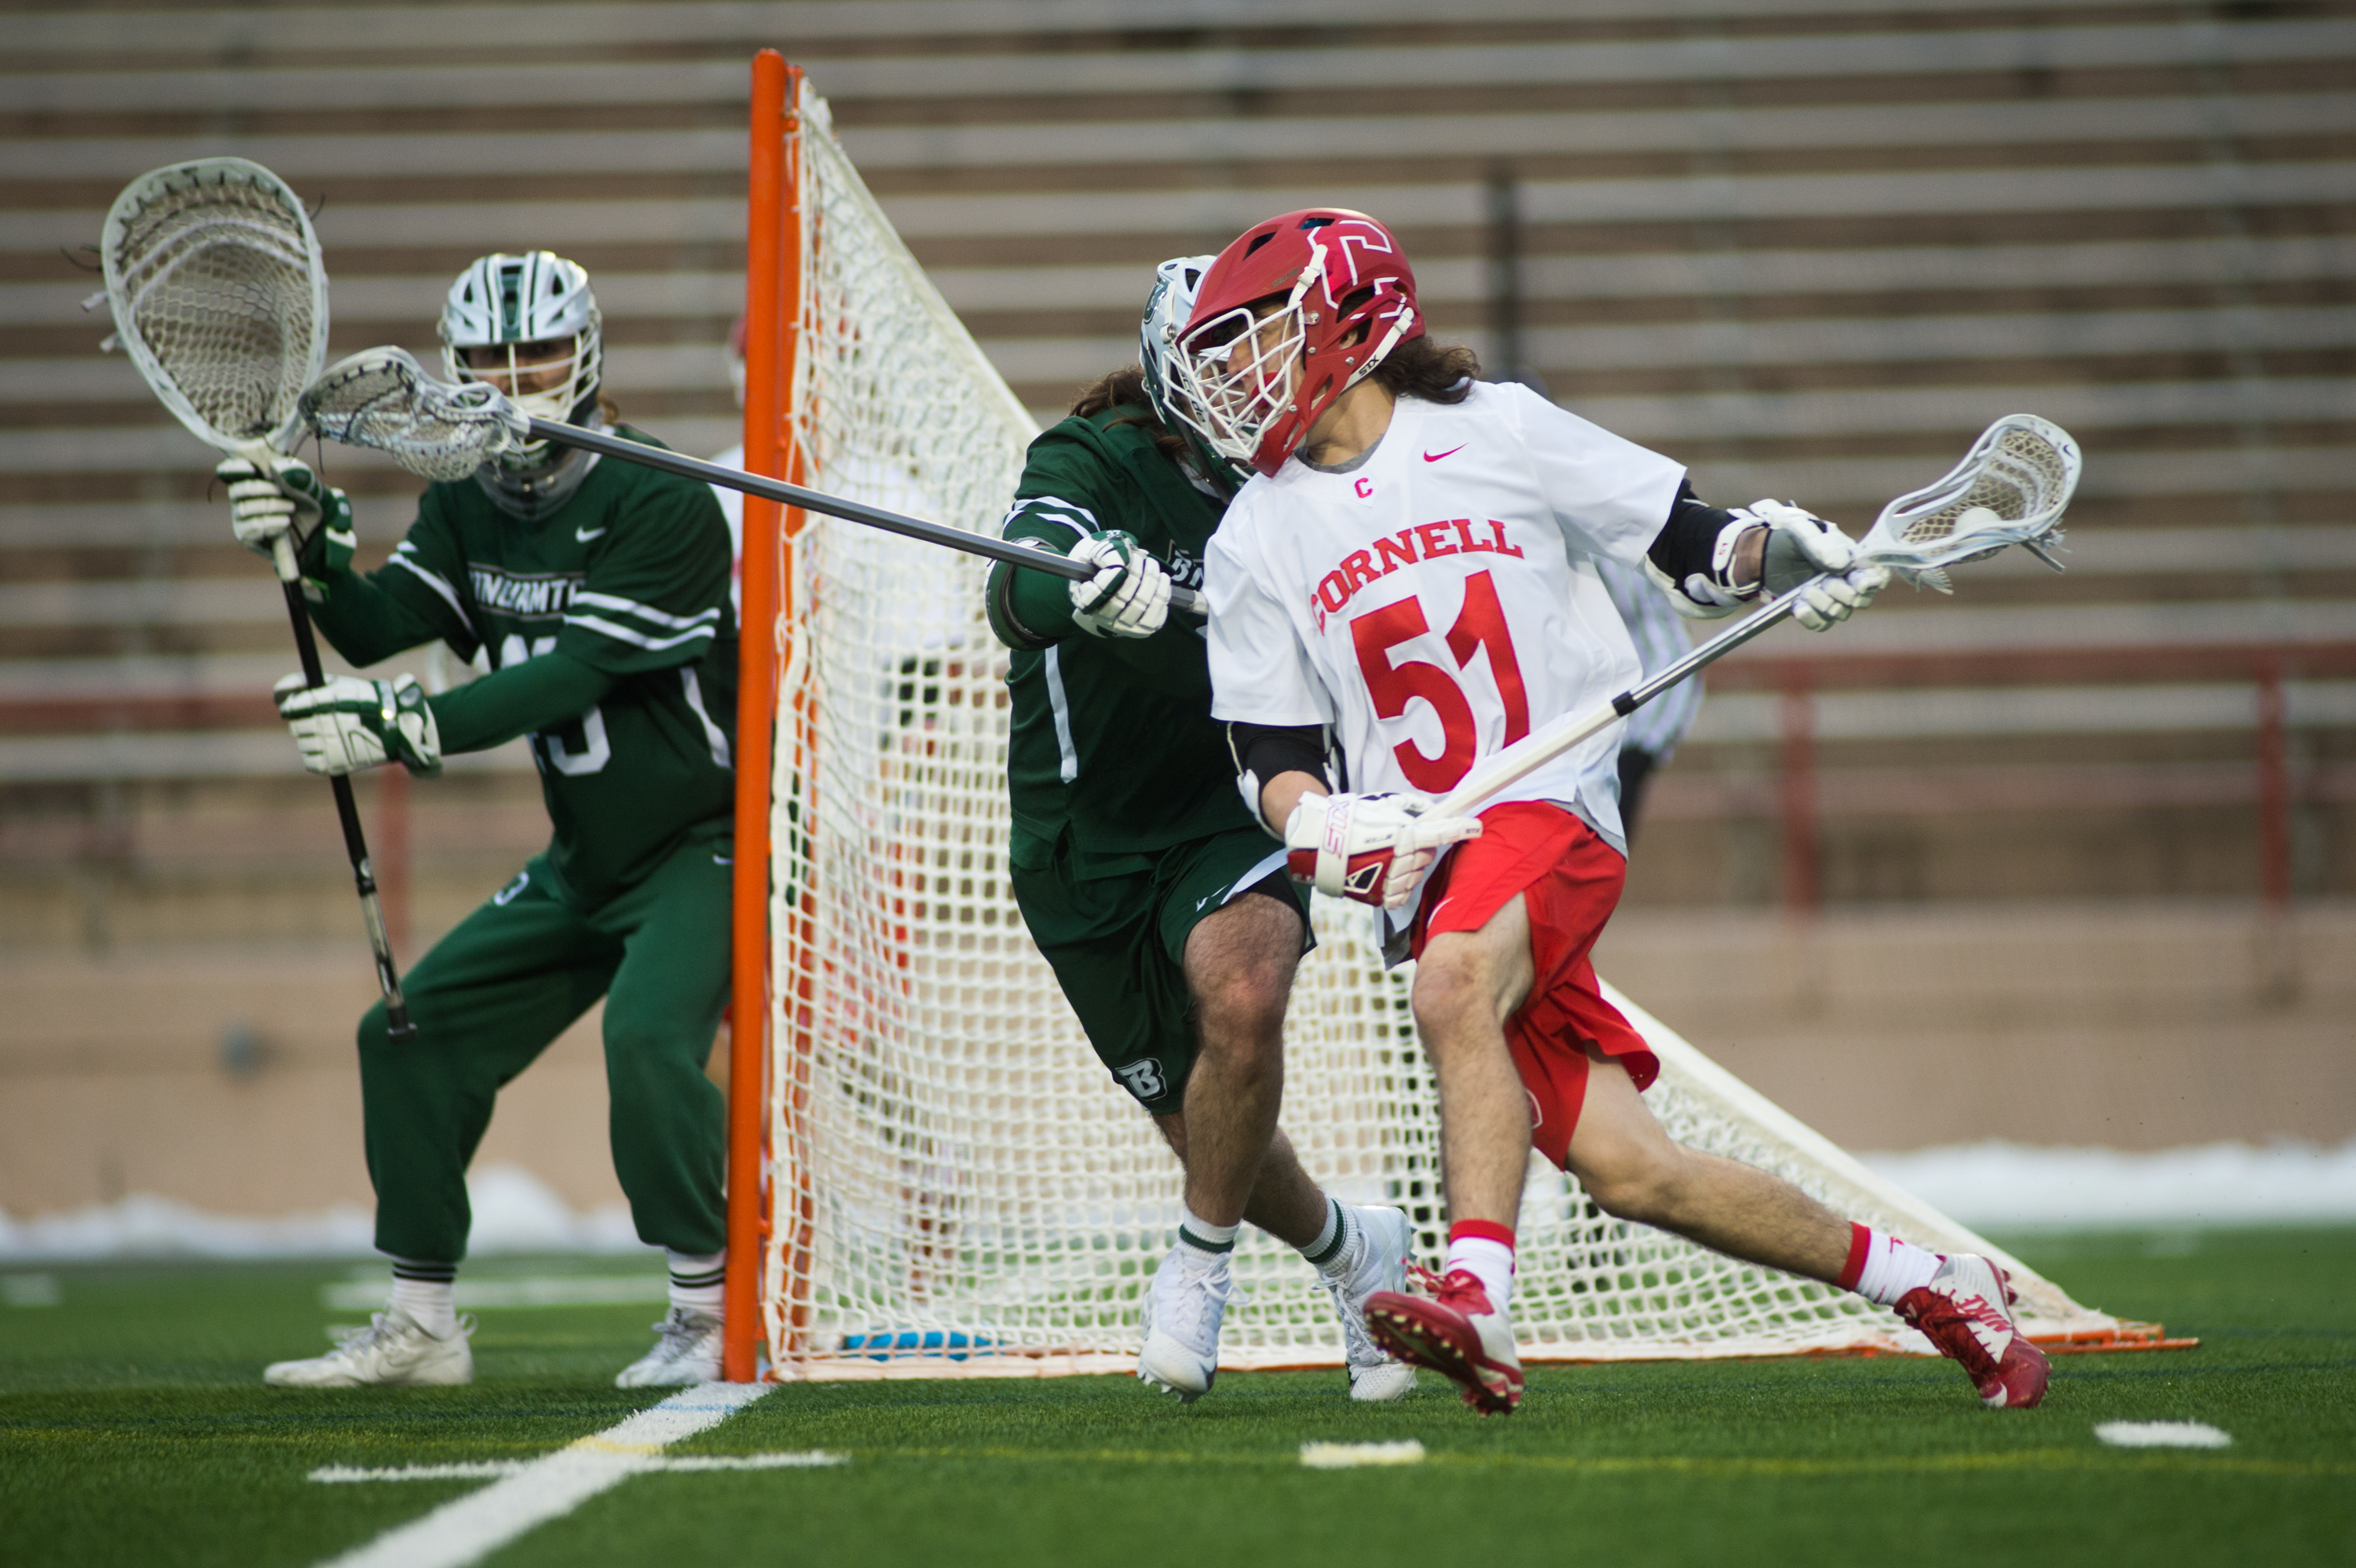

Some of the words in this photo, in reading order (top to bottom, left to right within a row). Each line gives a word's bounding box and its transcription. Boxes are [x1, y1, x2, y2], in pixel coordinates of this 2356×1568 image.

[1358, 353, 1380, 377] STX
[1354, 477, 1374, 499] C
[1311, 518, 1524, 636] CORNELL
[1349, 568, 1531, 794] 51
[1323, 796, 1350, 861] STX
[1114, 1058, 1168, 1101] B
